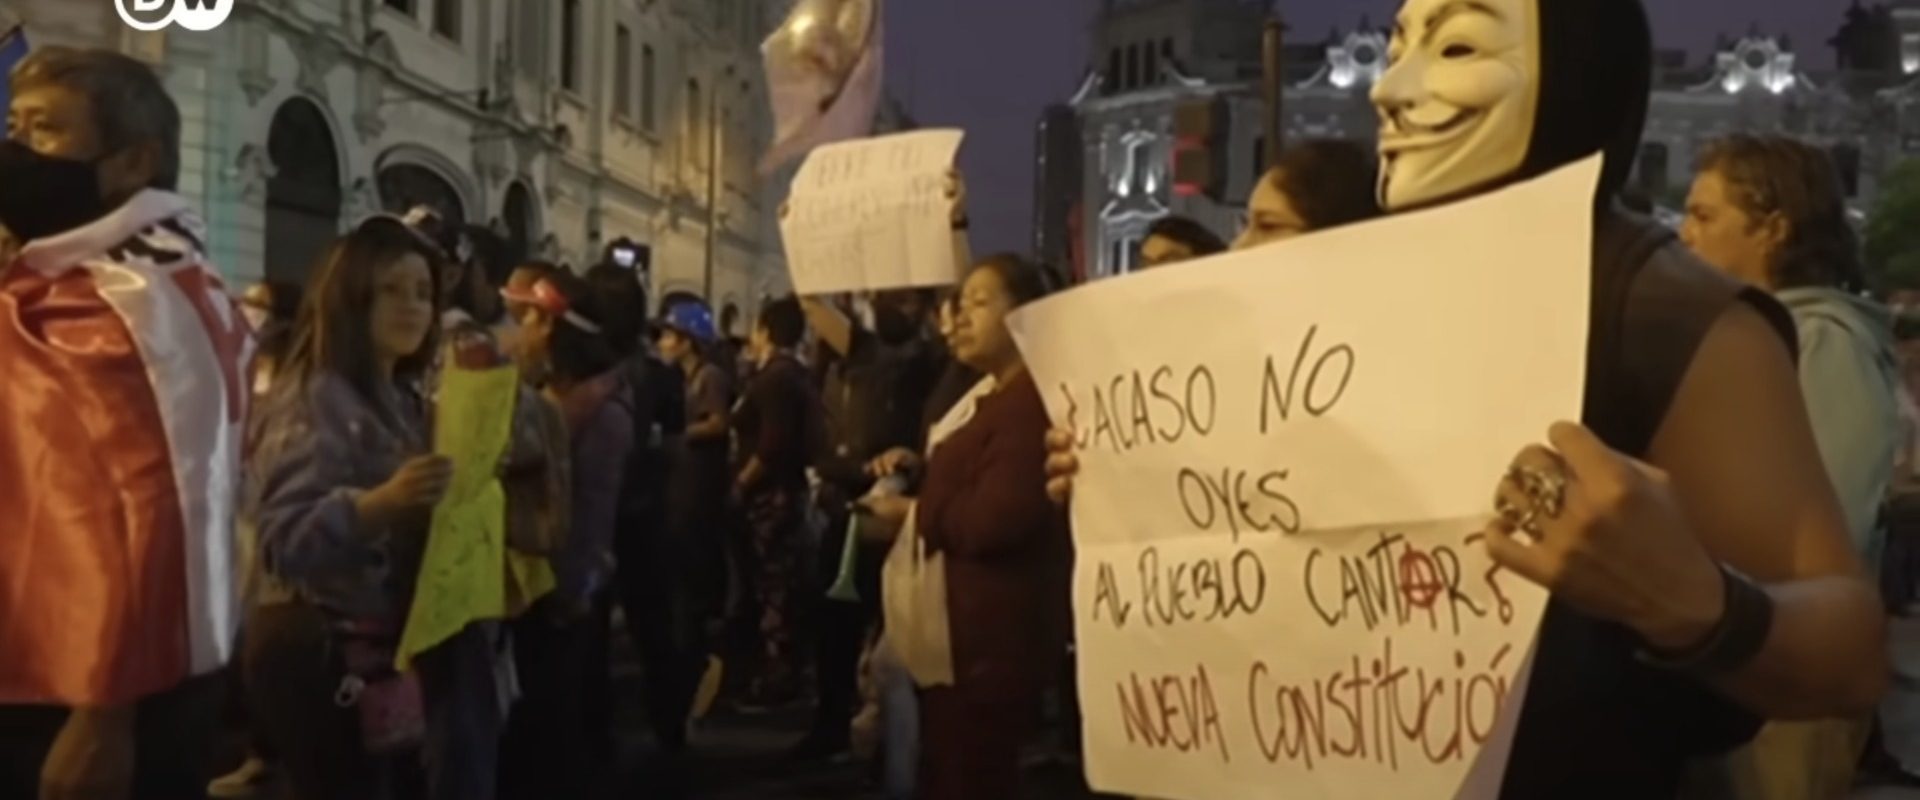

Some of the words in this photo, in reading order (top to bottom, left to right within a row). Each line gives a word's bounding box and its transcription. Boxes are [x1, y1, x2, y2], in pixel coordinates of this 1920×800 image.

[1260, 325, 1354, 434] NO
[1177, 467, 1300, 541] OYES
[1093, 561, 1131, 630] AL
[1138, 546, 1266, 628] PUEBLO
[1116, 661, 1230, 763] NUEVA
